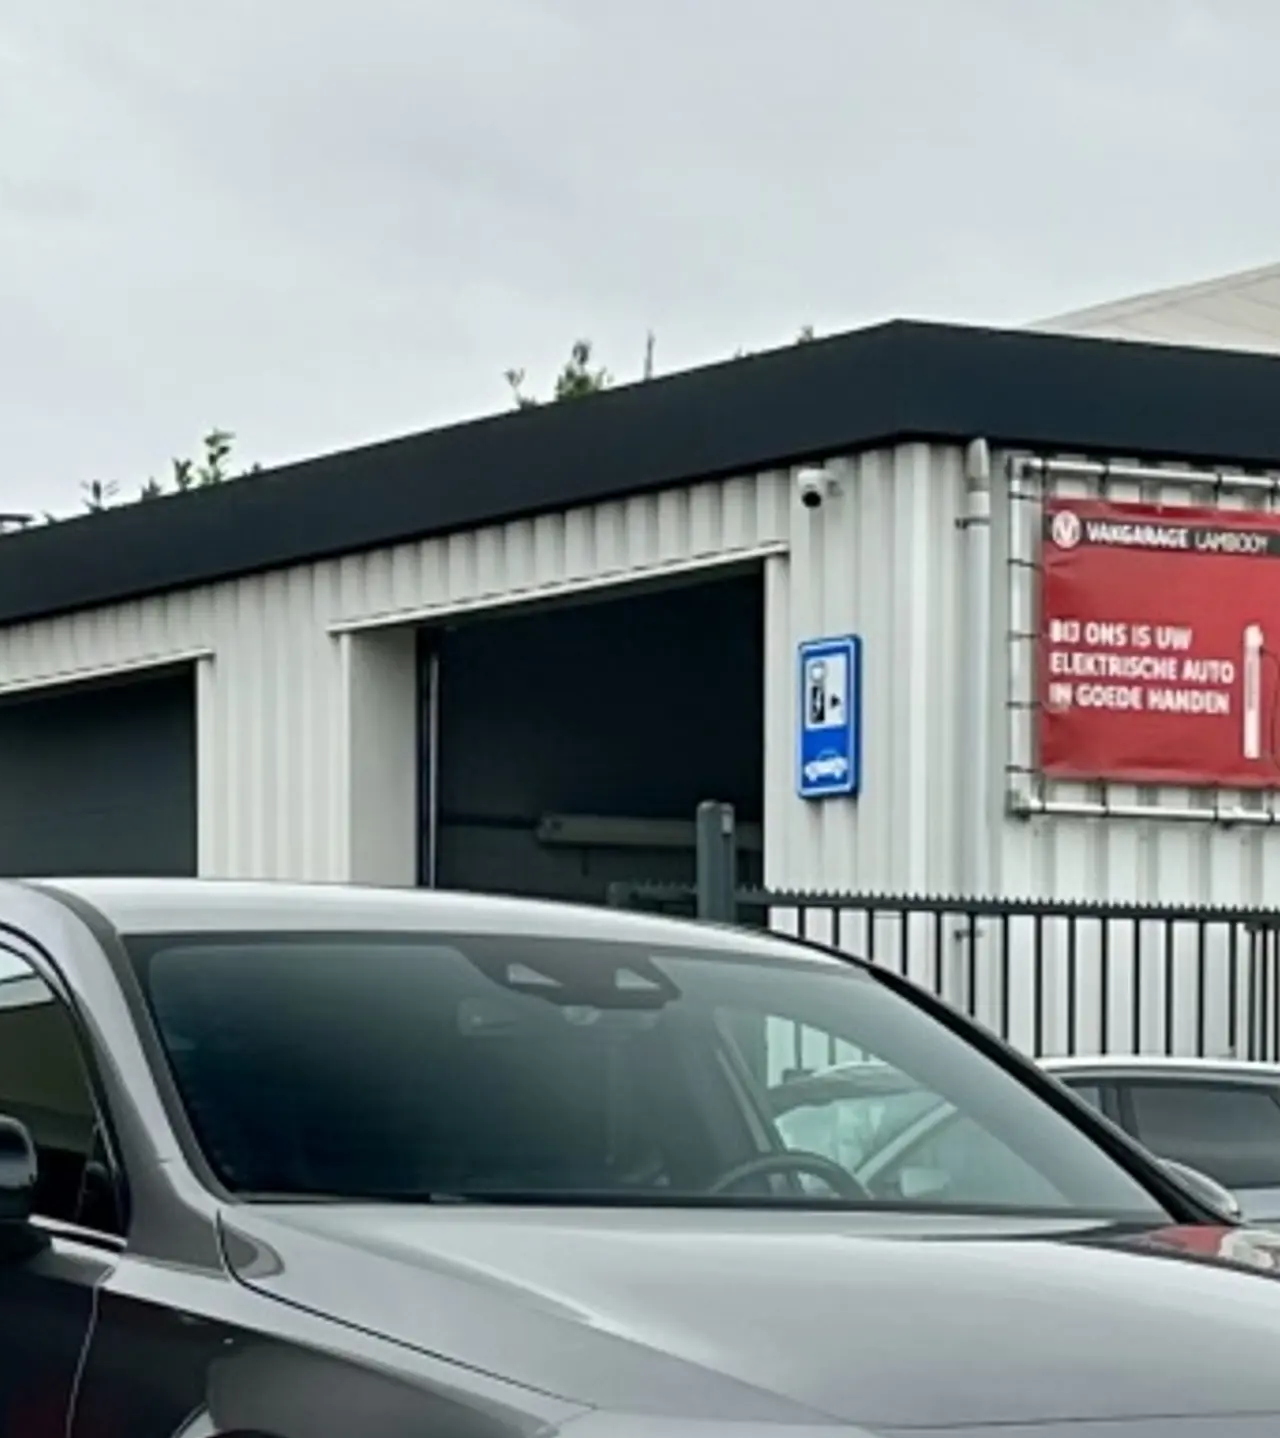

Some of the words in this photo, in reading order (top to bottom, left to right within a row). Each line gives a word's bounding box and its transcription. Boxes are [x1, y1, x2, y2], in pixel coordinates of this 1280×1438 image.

[1086, 521, 1188, 548] VAKGARAGE
[1050, 619, 1080, 644] BIJ
[1085, 622, 1127, 646] ONS
[1131, 625, 1150, 647] IS
[1156, 626, 1192, 650] UW
[1050, 652, 1177, 679] ELEKTRISCHE
[1182, 659, 1234, 684] AUTO
[1049, 682, 1072, 707] IN
[1076, 685, 1143, 710] GOEDE
[1147, 689, 1230, 714] HANDEN
